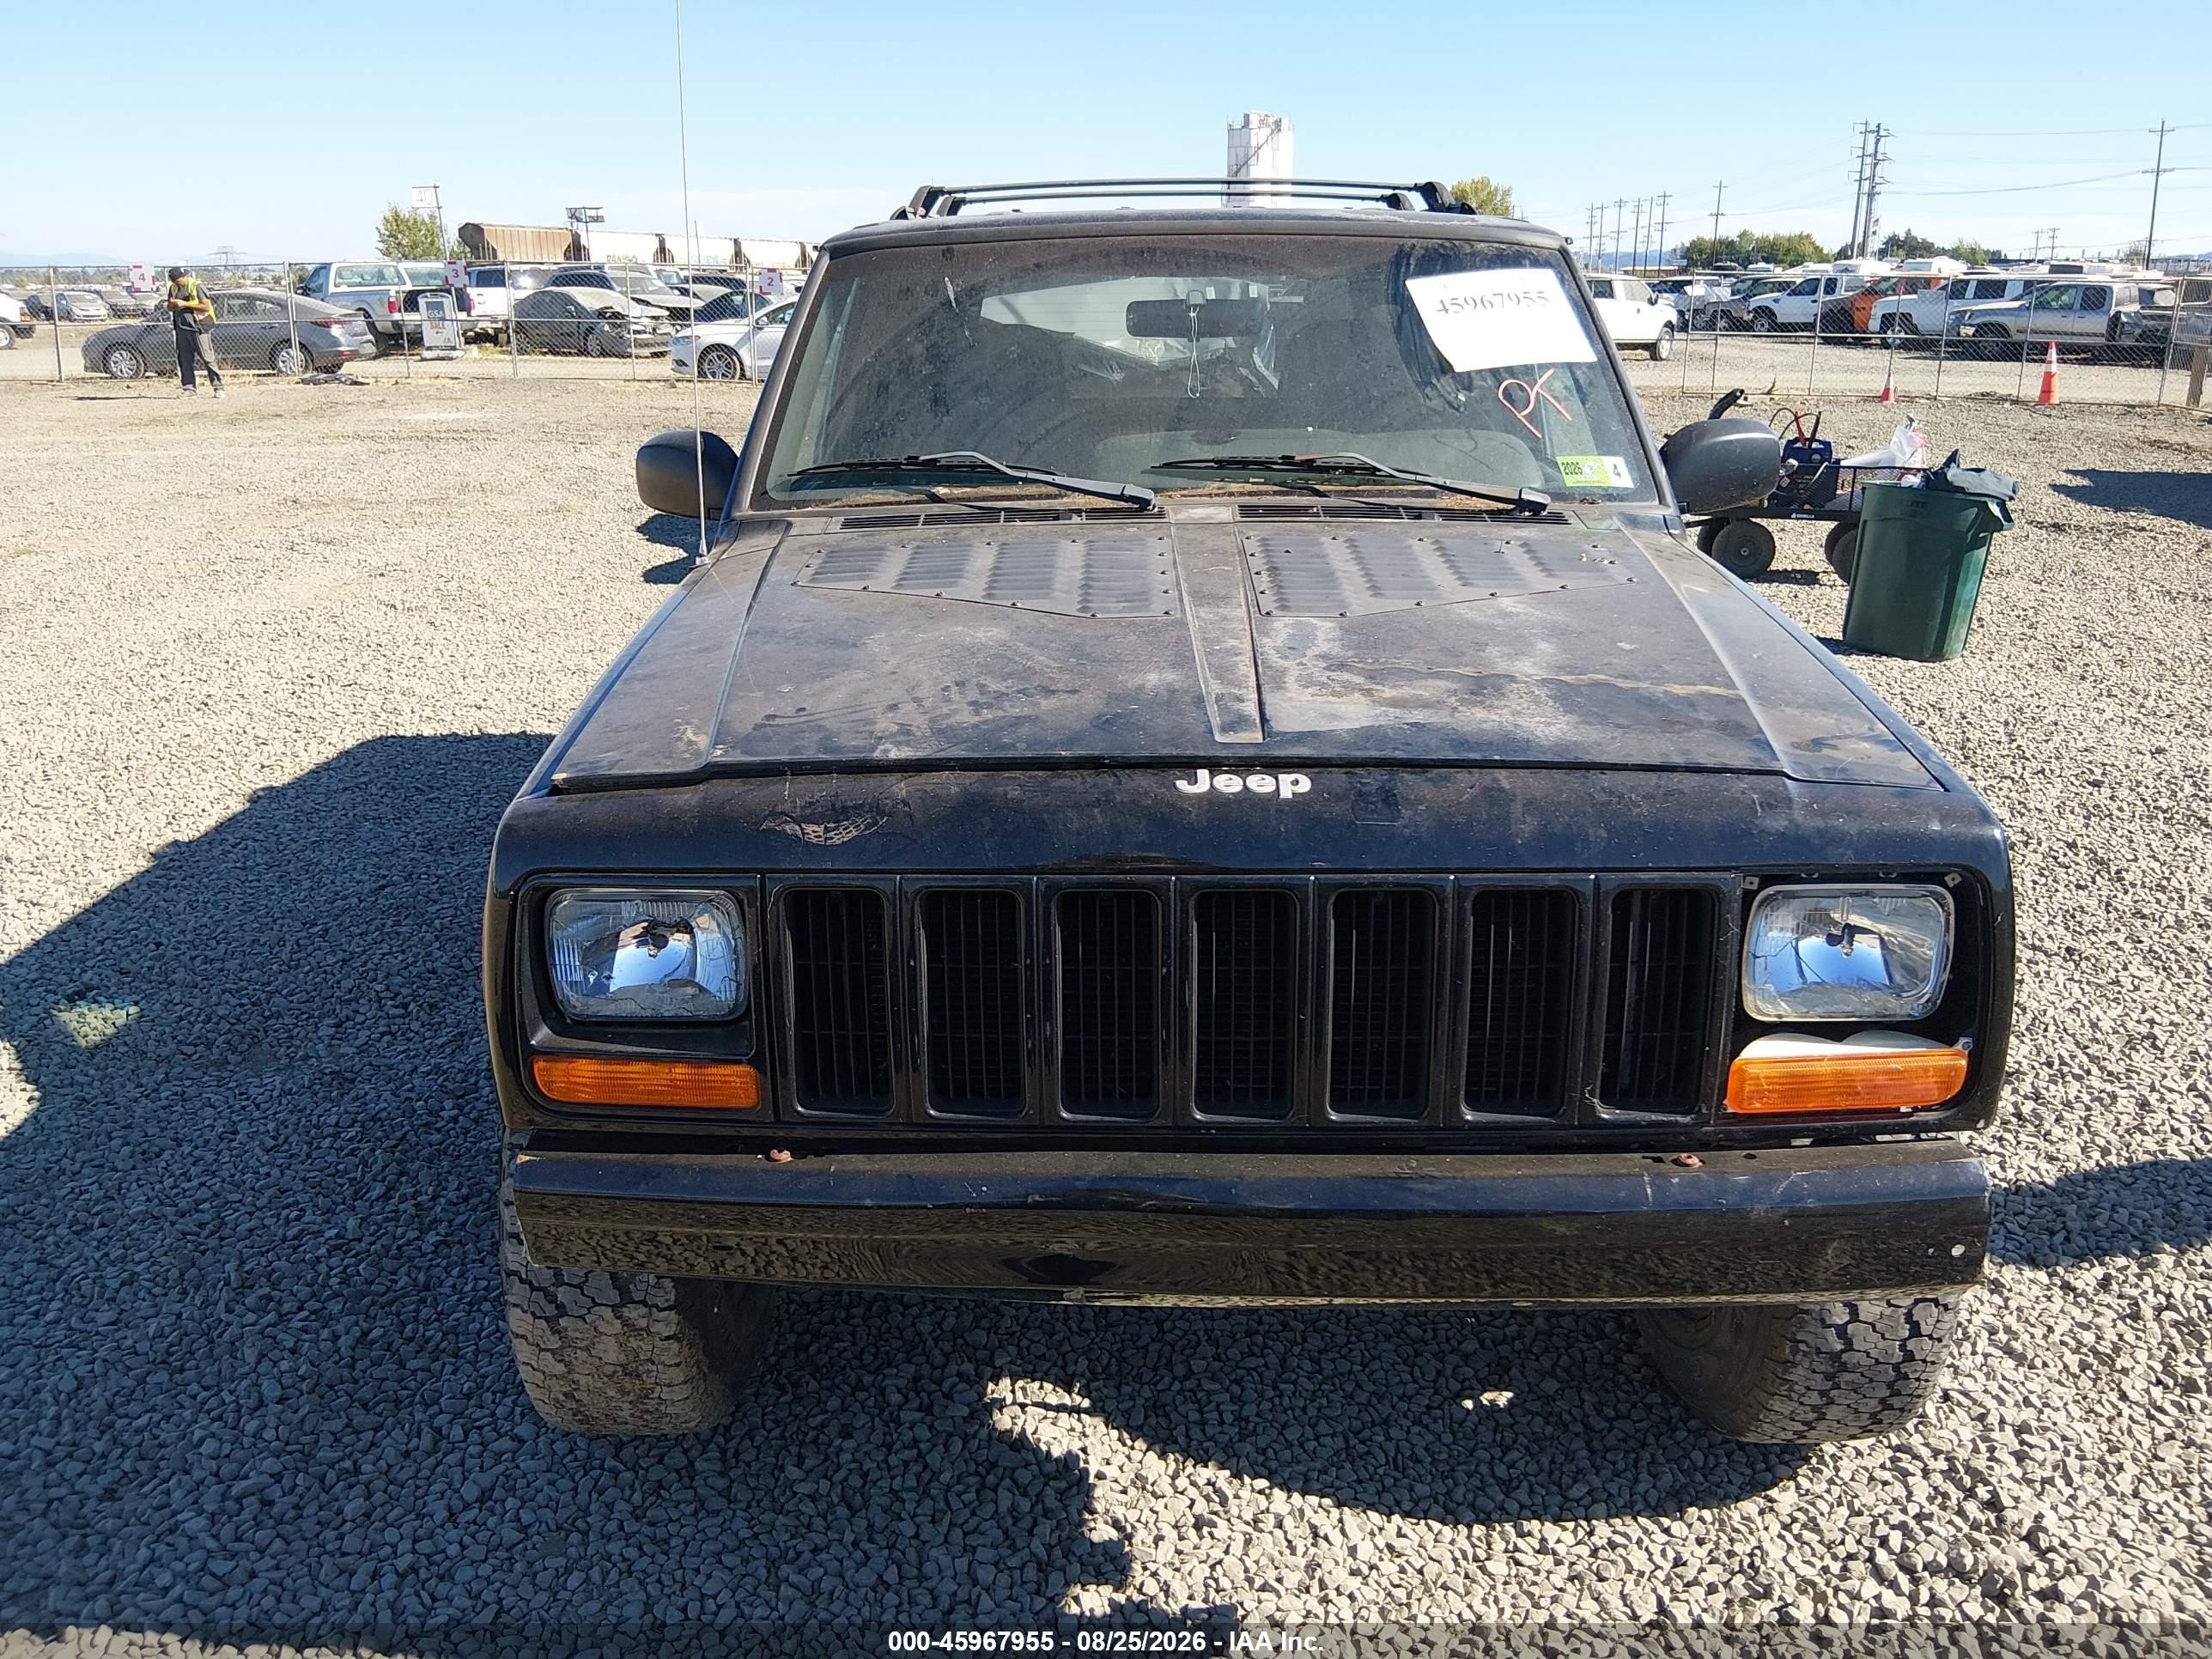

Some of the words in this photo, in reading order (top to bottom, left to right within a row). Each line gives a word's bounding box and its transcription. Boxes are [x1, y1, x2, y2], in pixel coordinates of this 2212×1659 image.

[138, 272, 146, 282] 4
[452, 268, 459, 278] 3
[767, 276, 774, 287] 2
[1436, 290, 1551, 315] 45967955
[428, 309, 444, 318] GSA
[1561, 461, 1583, 476] 2026
[1613, 464, 1621, 479] 4
[1174, 769, 1312, 799] Jeep
